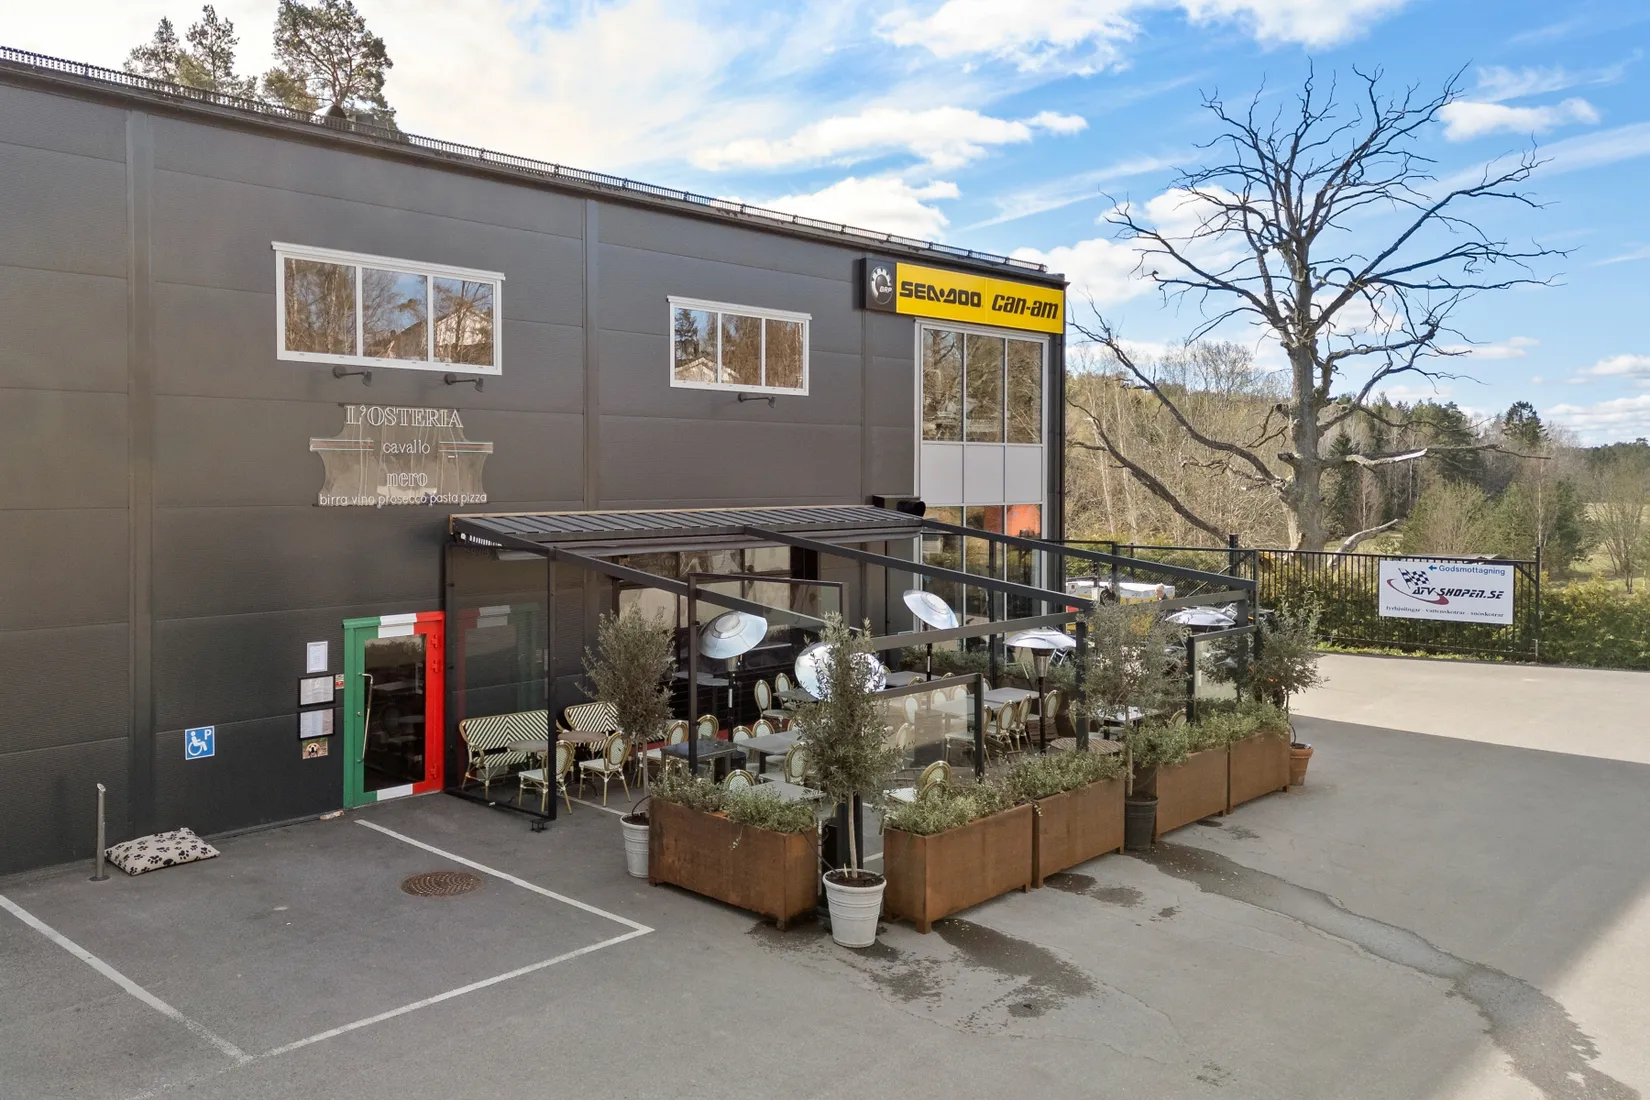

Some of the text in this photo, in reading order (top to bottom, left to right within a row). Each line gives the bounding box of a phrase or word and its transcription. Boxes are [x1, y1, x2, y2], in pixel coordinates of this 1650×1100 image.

[345, 405, 464, 428] L'OSTERIA
[383, 439, 431, 454] cavallo
[386, 472, 428, 487] nero
[319, 492, 487, 508] birra vino prosecco pasta pizza
[1439, 565, 1506, 576] Godsmottagning
[204, 729, 212, 740] P
